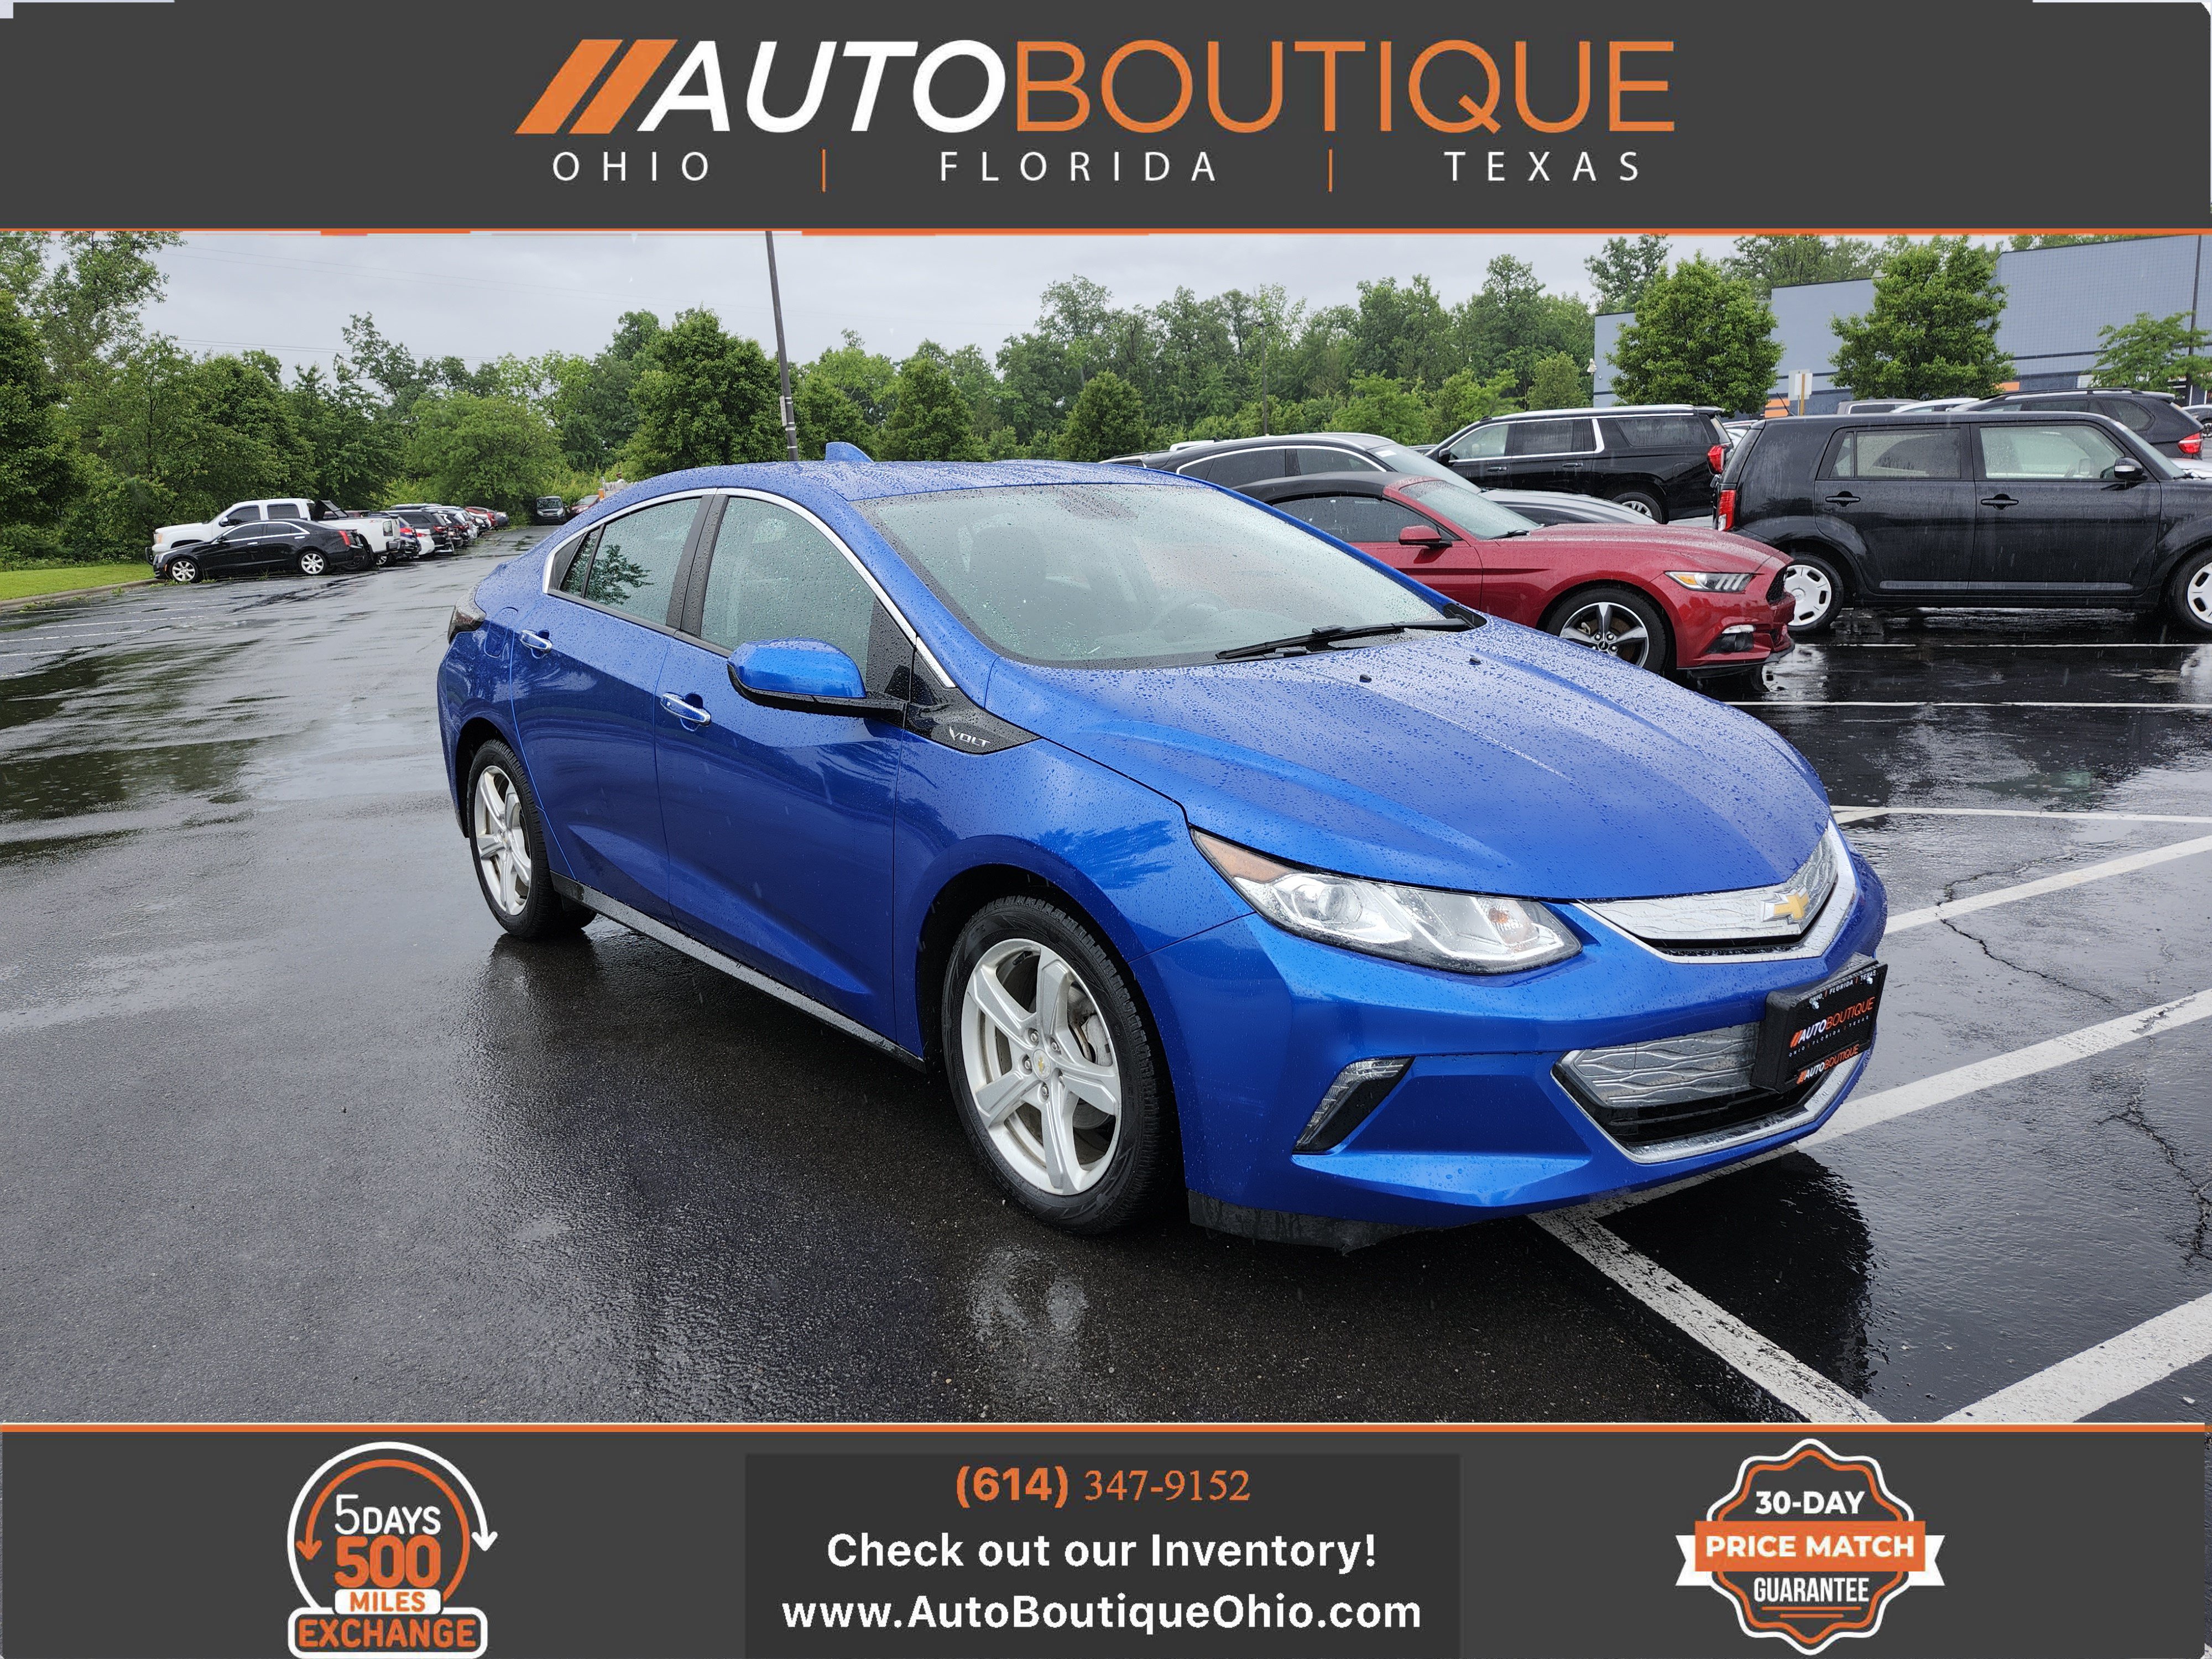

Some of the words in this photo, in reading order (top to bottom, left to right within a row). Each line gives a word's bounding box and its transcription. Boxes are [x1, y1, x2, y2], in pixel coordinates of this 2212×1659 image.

[949, 726, 991, 747] VOLT
[1829, 980, 1853, 994] FLORIDA
[1860, 970, 1876, 981] TEXAS
[1798, 997, 1875, 1044] AUTOBOUTIQUE
